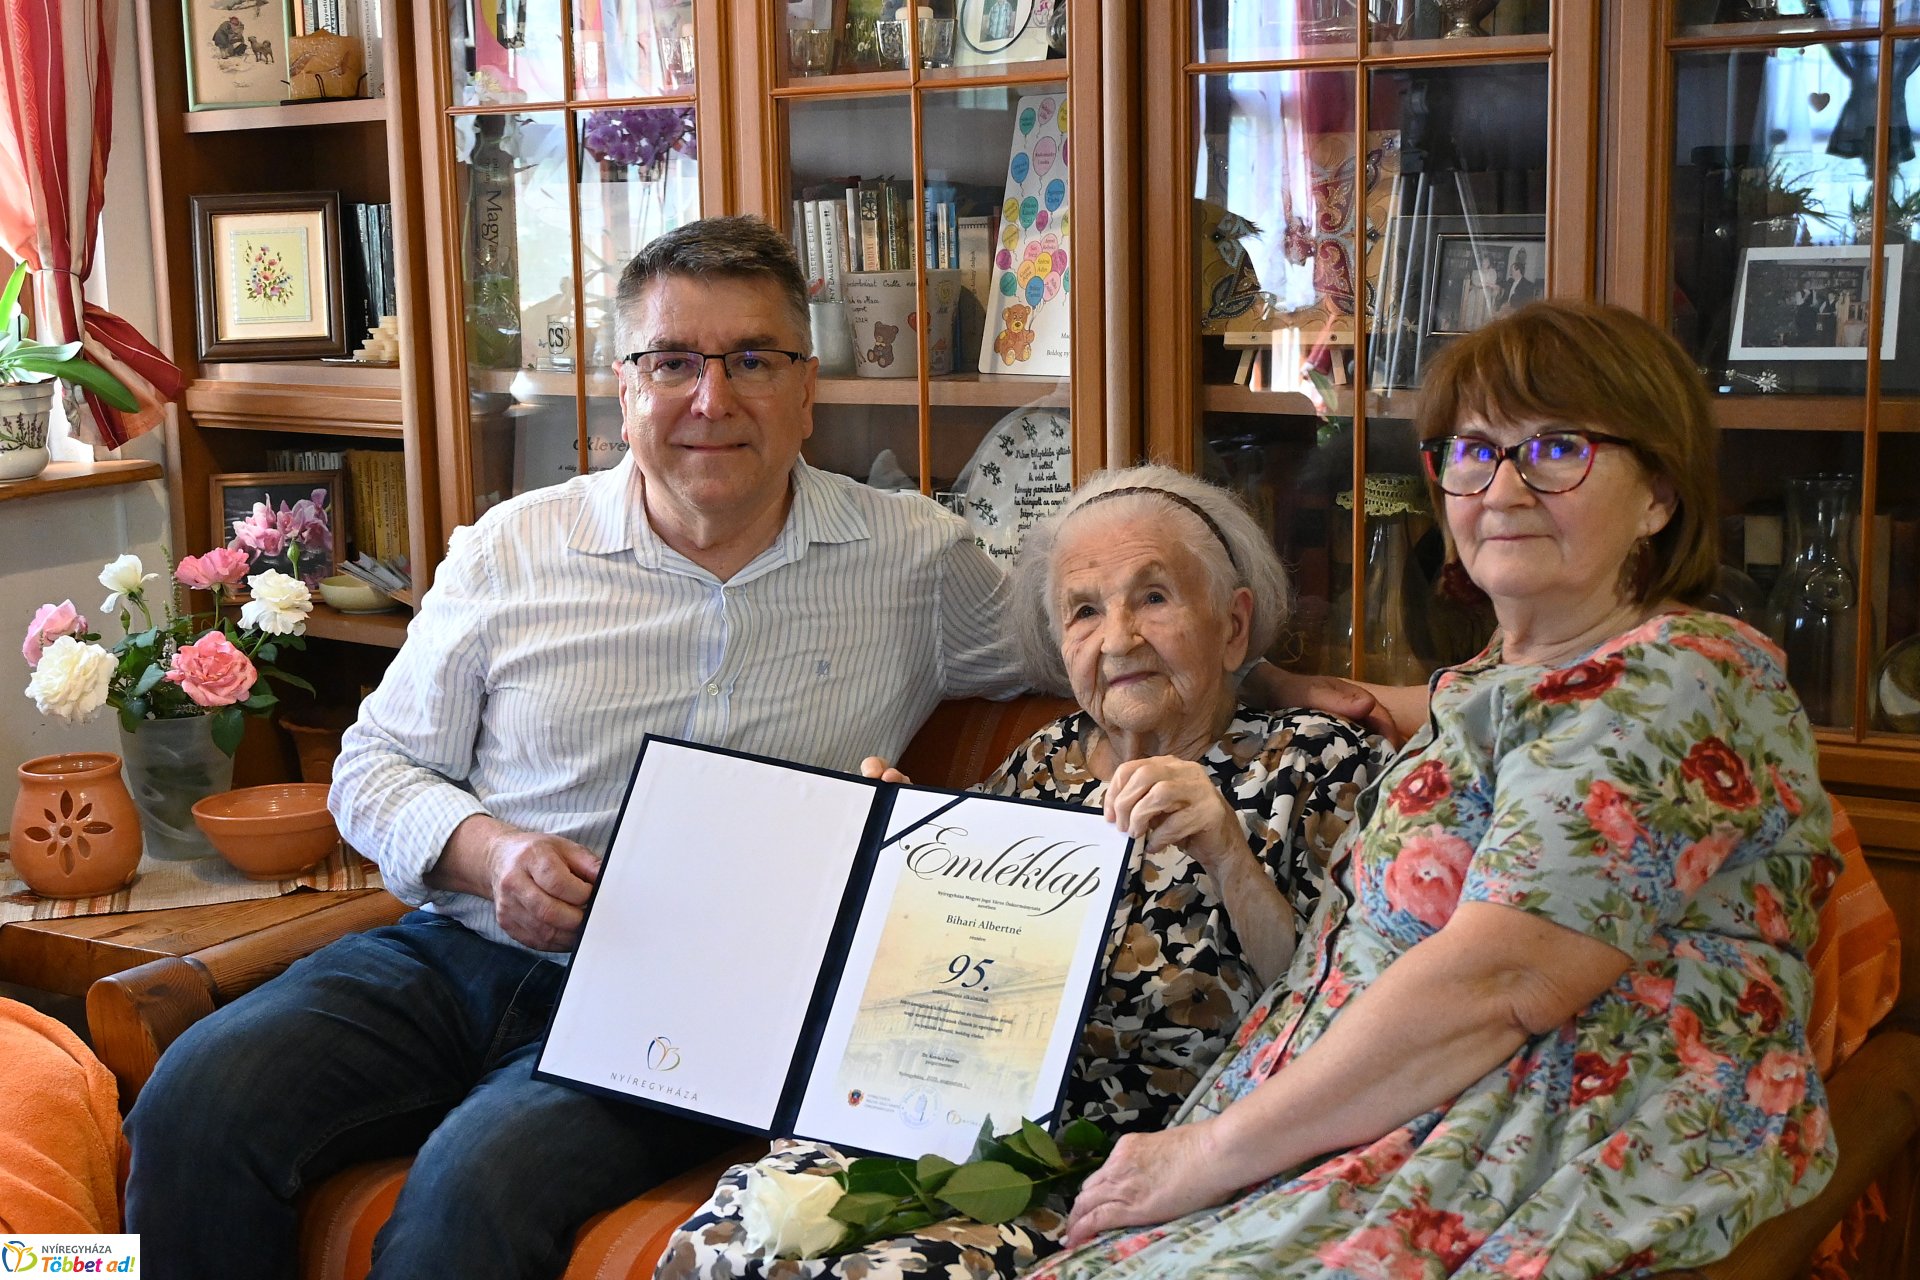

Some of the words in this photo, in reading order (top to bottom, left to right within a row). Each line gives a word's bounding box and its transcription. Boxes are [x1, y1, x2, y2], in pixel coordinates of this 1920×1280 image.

[481, 190, 503, 254] Magya
[809, 248, 817, 280] MBEREK
[899, 823, 1101, 917] Emléklap
[946, 914, 977, 929] Bihari
[978, 920, 1022, 936] Albertné
[939, 954, 995, 992] 95.
[610, 1072, 698, 1101] NYÍREGYHÁZA
